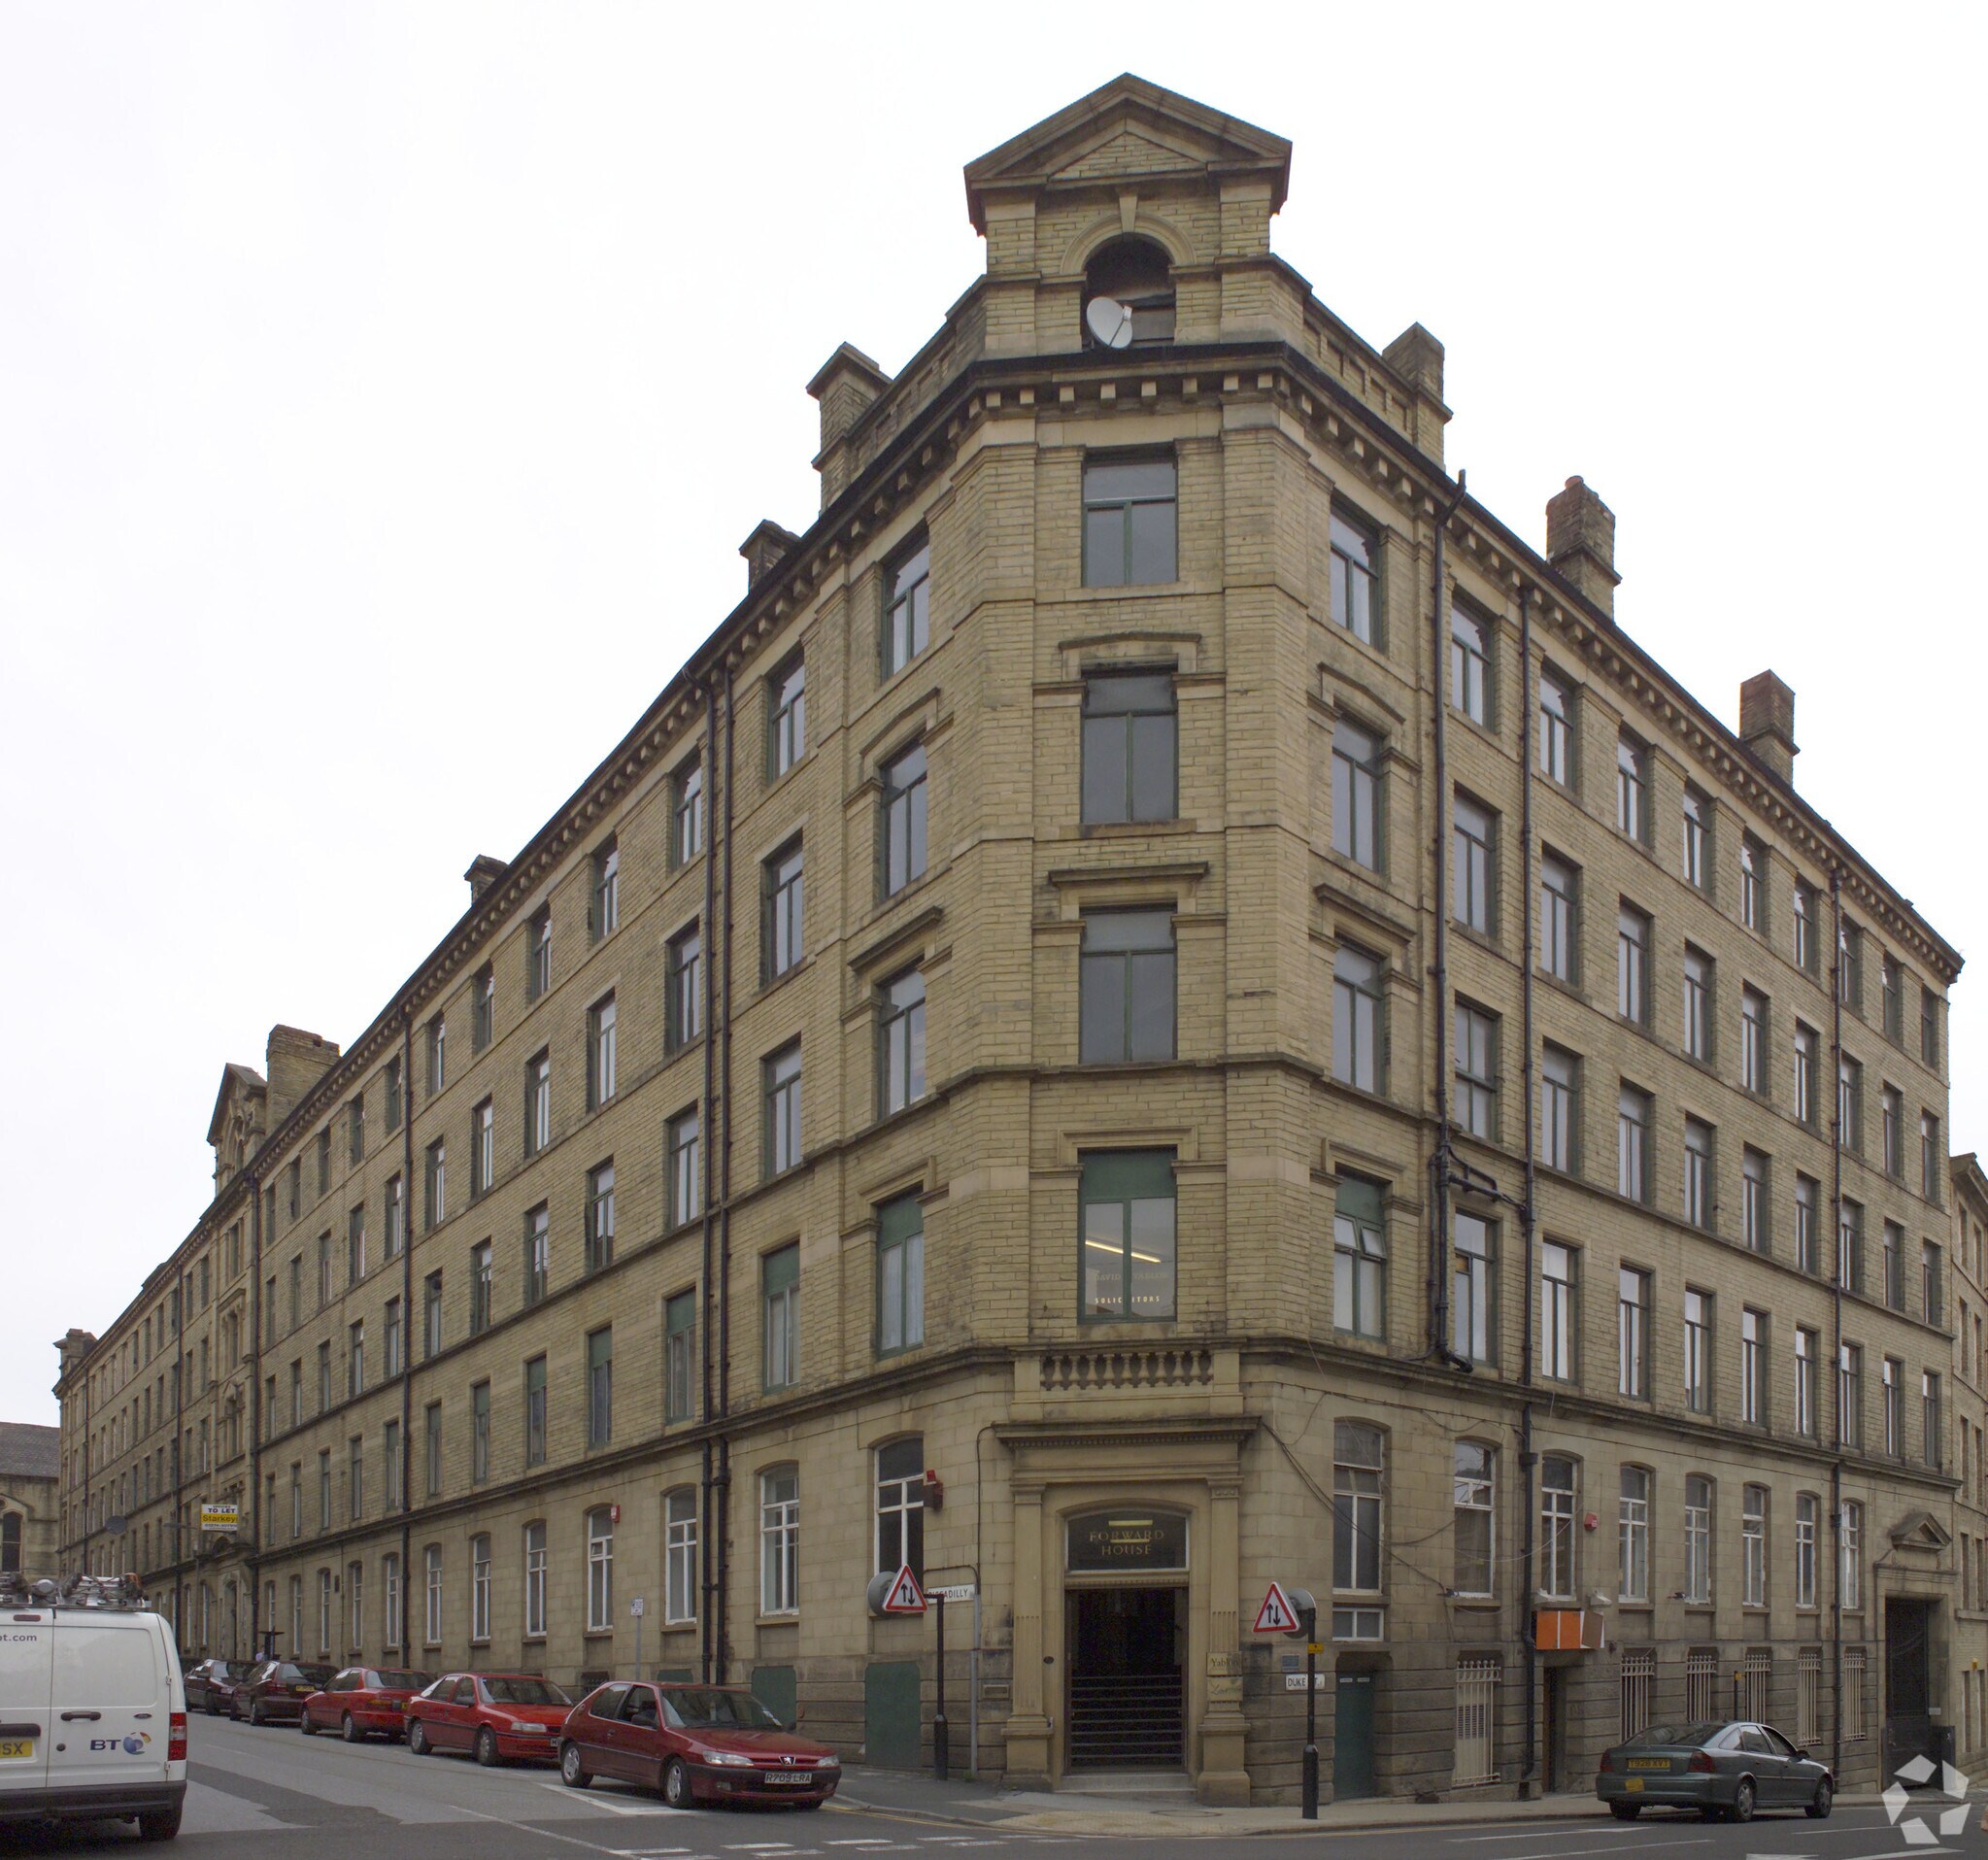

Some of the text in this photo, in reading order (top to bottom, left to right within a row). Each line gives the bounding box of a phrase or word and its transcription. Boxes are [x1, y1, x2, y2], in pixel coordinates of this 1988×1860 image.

[1089, 1529, 1165, 1542] FORWARD
[1101, 1544, 1153, 1556] HOUSE
[1287, 1676, 1306, 1687] DUKE
[89, 1740, 121, 1750] BT
